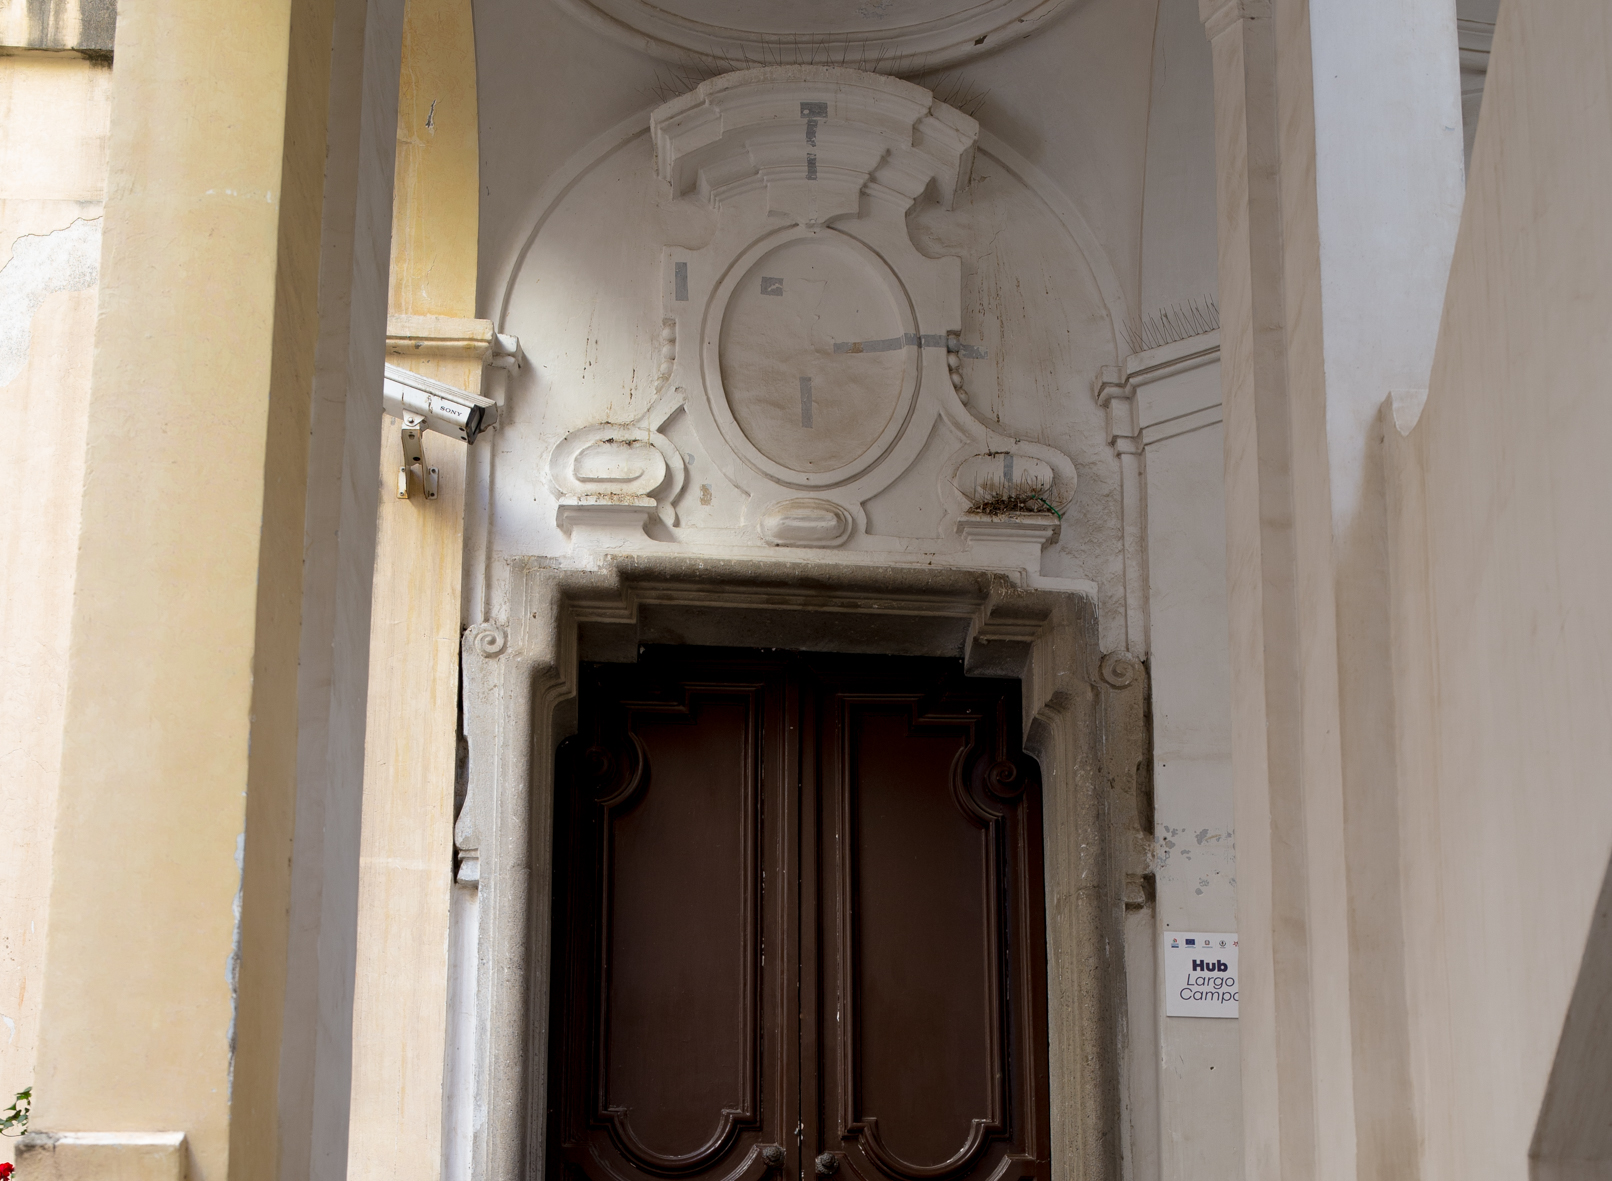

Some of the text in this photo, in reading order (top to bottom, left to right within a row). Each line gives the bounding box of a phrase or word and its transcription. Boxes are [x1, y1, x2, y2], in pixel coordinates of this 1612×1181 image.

[440, 405, 462, 417] SONY
[1192, 959, 1228, 972] Hub
[1187, 973, 1235, 990] Largo
